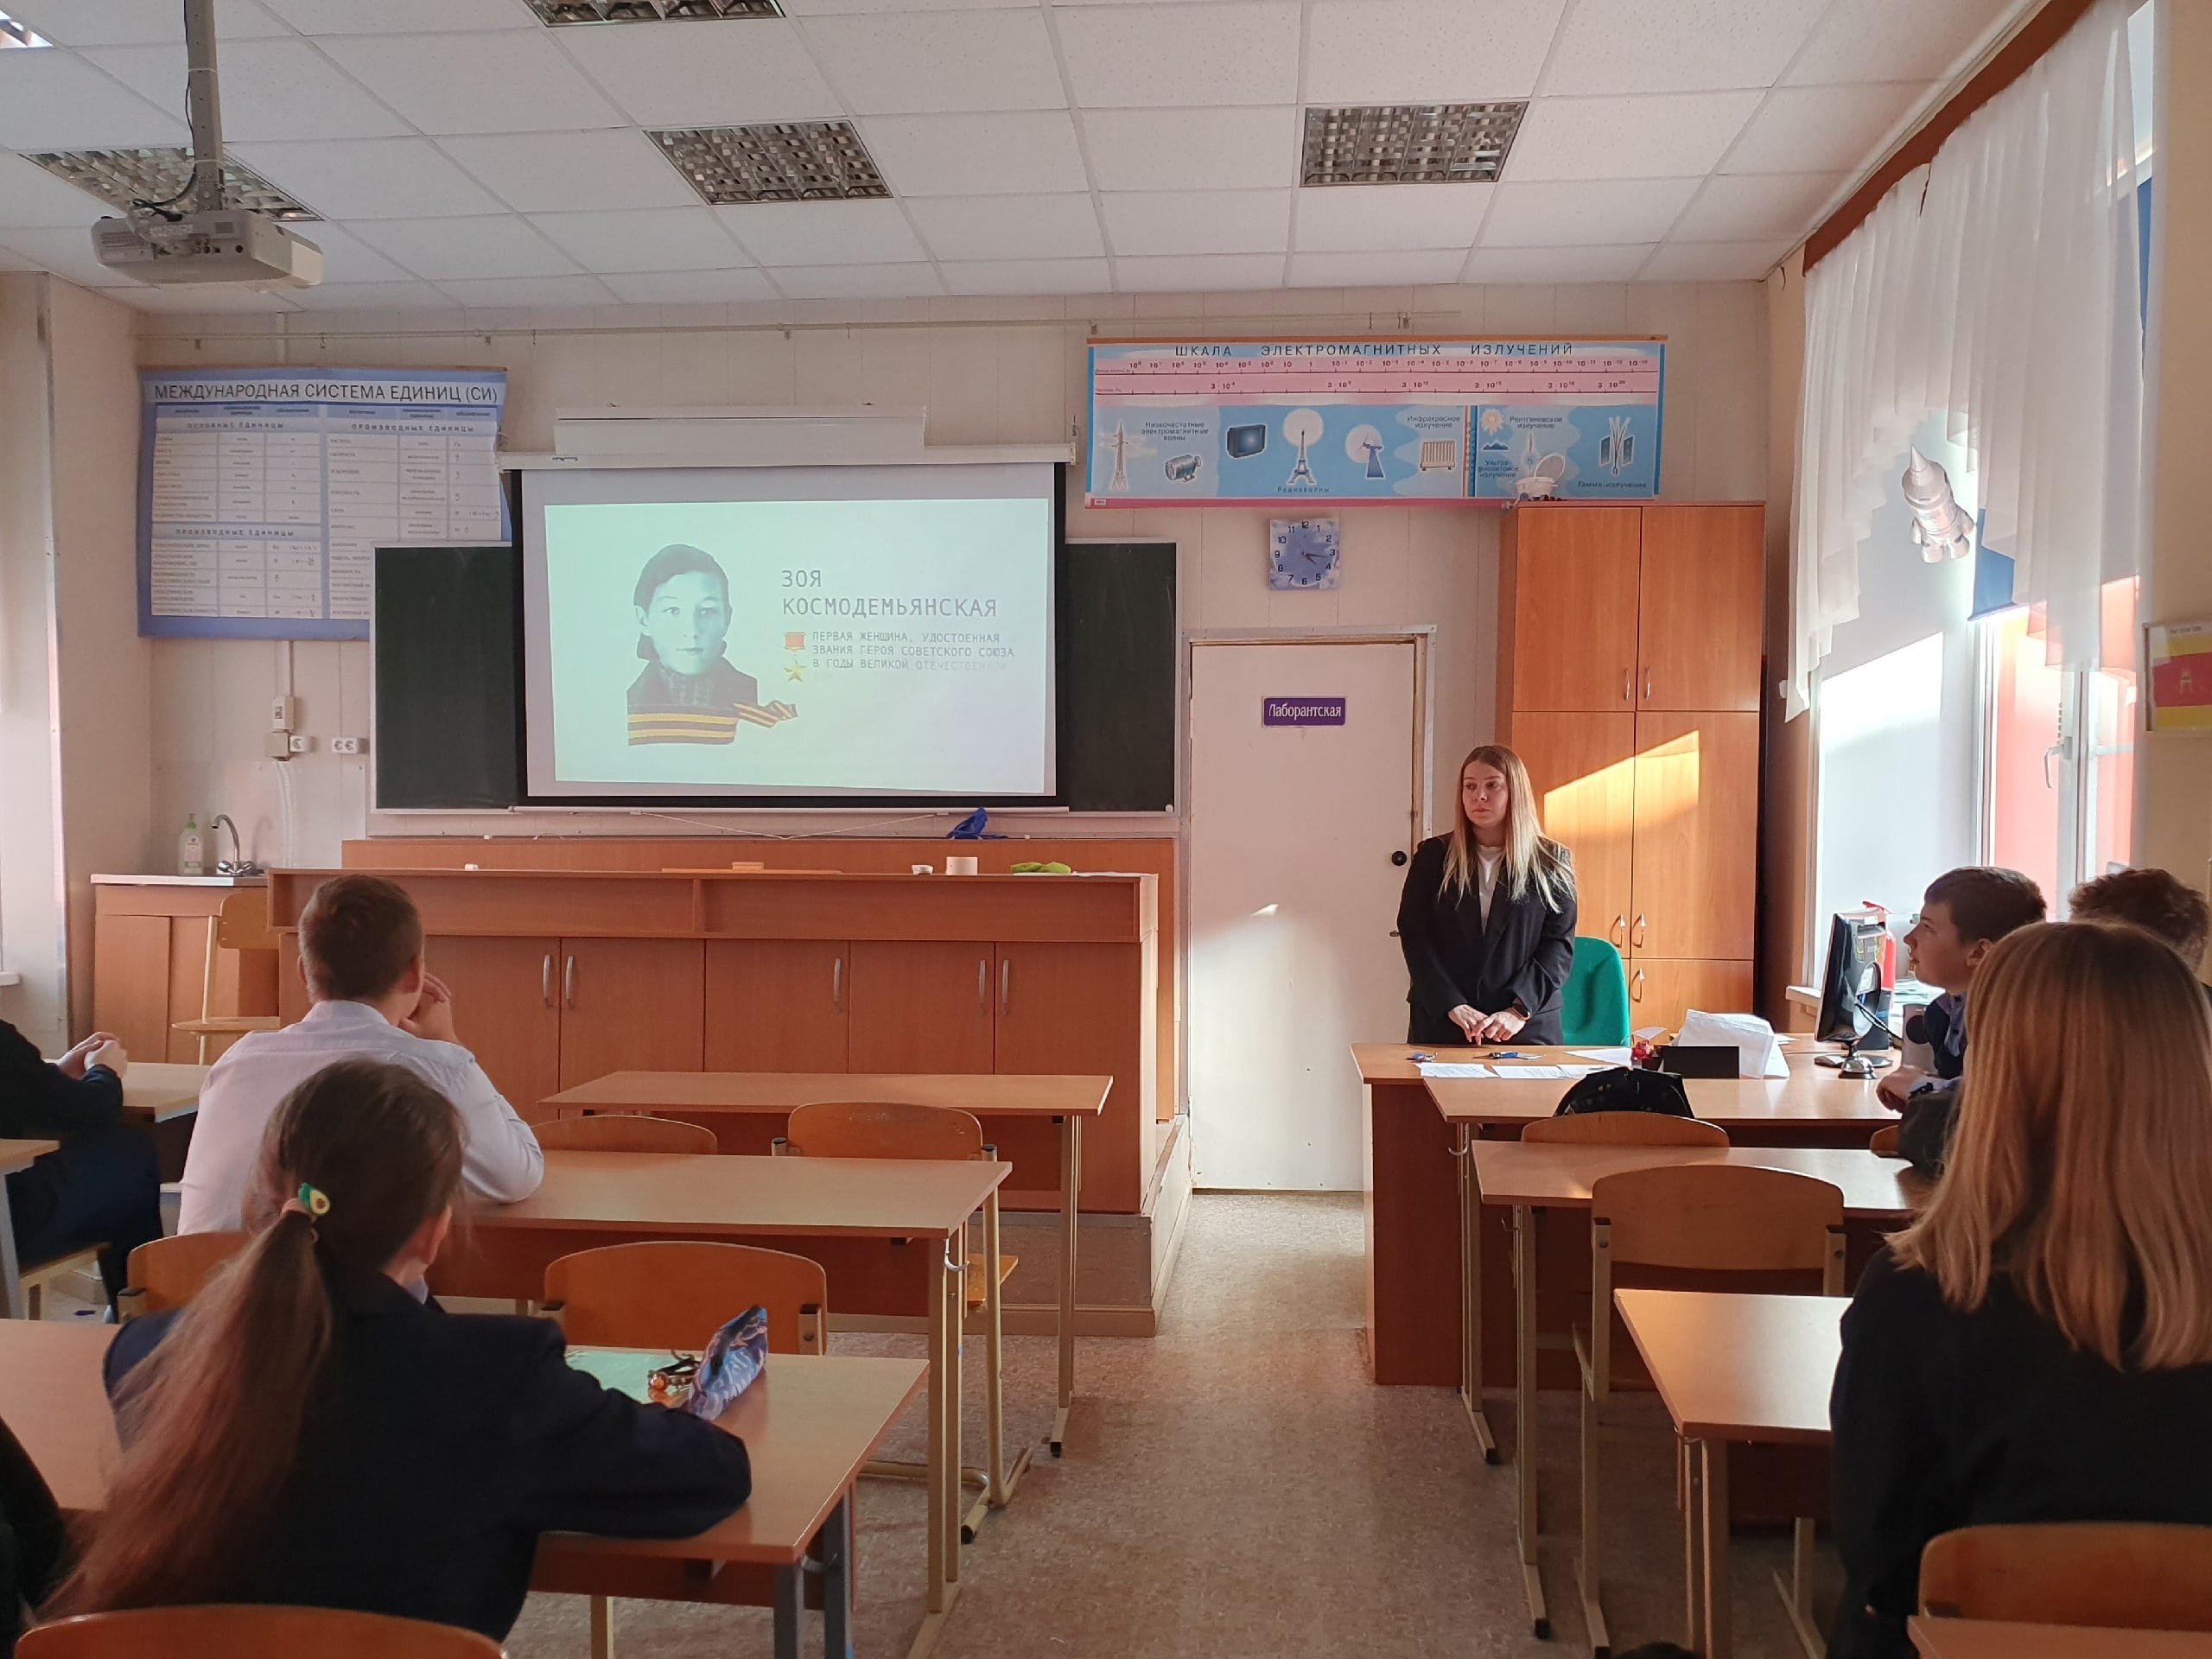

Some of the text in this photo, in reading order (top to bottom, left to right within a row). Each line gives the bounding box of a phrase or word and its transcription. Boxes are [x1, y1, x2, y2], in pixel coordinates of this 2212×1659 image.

[1175, 342, 1573, 356] ШКАЛА ЭЛЕКТРОМАГНИТНЫХ ИЗЛУЧЕНИЙ
[155, 383, 498, 404] МЕЖДУНАРОДНАЯ СИСТЕМА ЕДИНИЦ (СИ)
[1407, 415, 1460, 423] Инфракрасное
[781, 569, 822, 588] ЗОЯ
[783, 597, 996, 619] КОСМОДЕМЬЯНСКАЯ
[812, 631, 853, 642] ПЕРВАЯ
[921, 632, 1000, 644] УДОСТОЕННАЯ
[812, 645, 1014, 658] ЗВАНИЯ ГЕРОЯ СОВЕТСКОГО СОЮЗА
[812, 658, 819, 668] В
[826, 658, 853, 669] ГОДЫ
[860, 658, 908, 670] ВЕЛИКОЙ
[1268, 702, 1342, 721] Лаборантская
